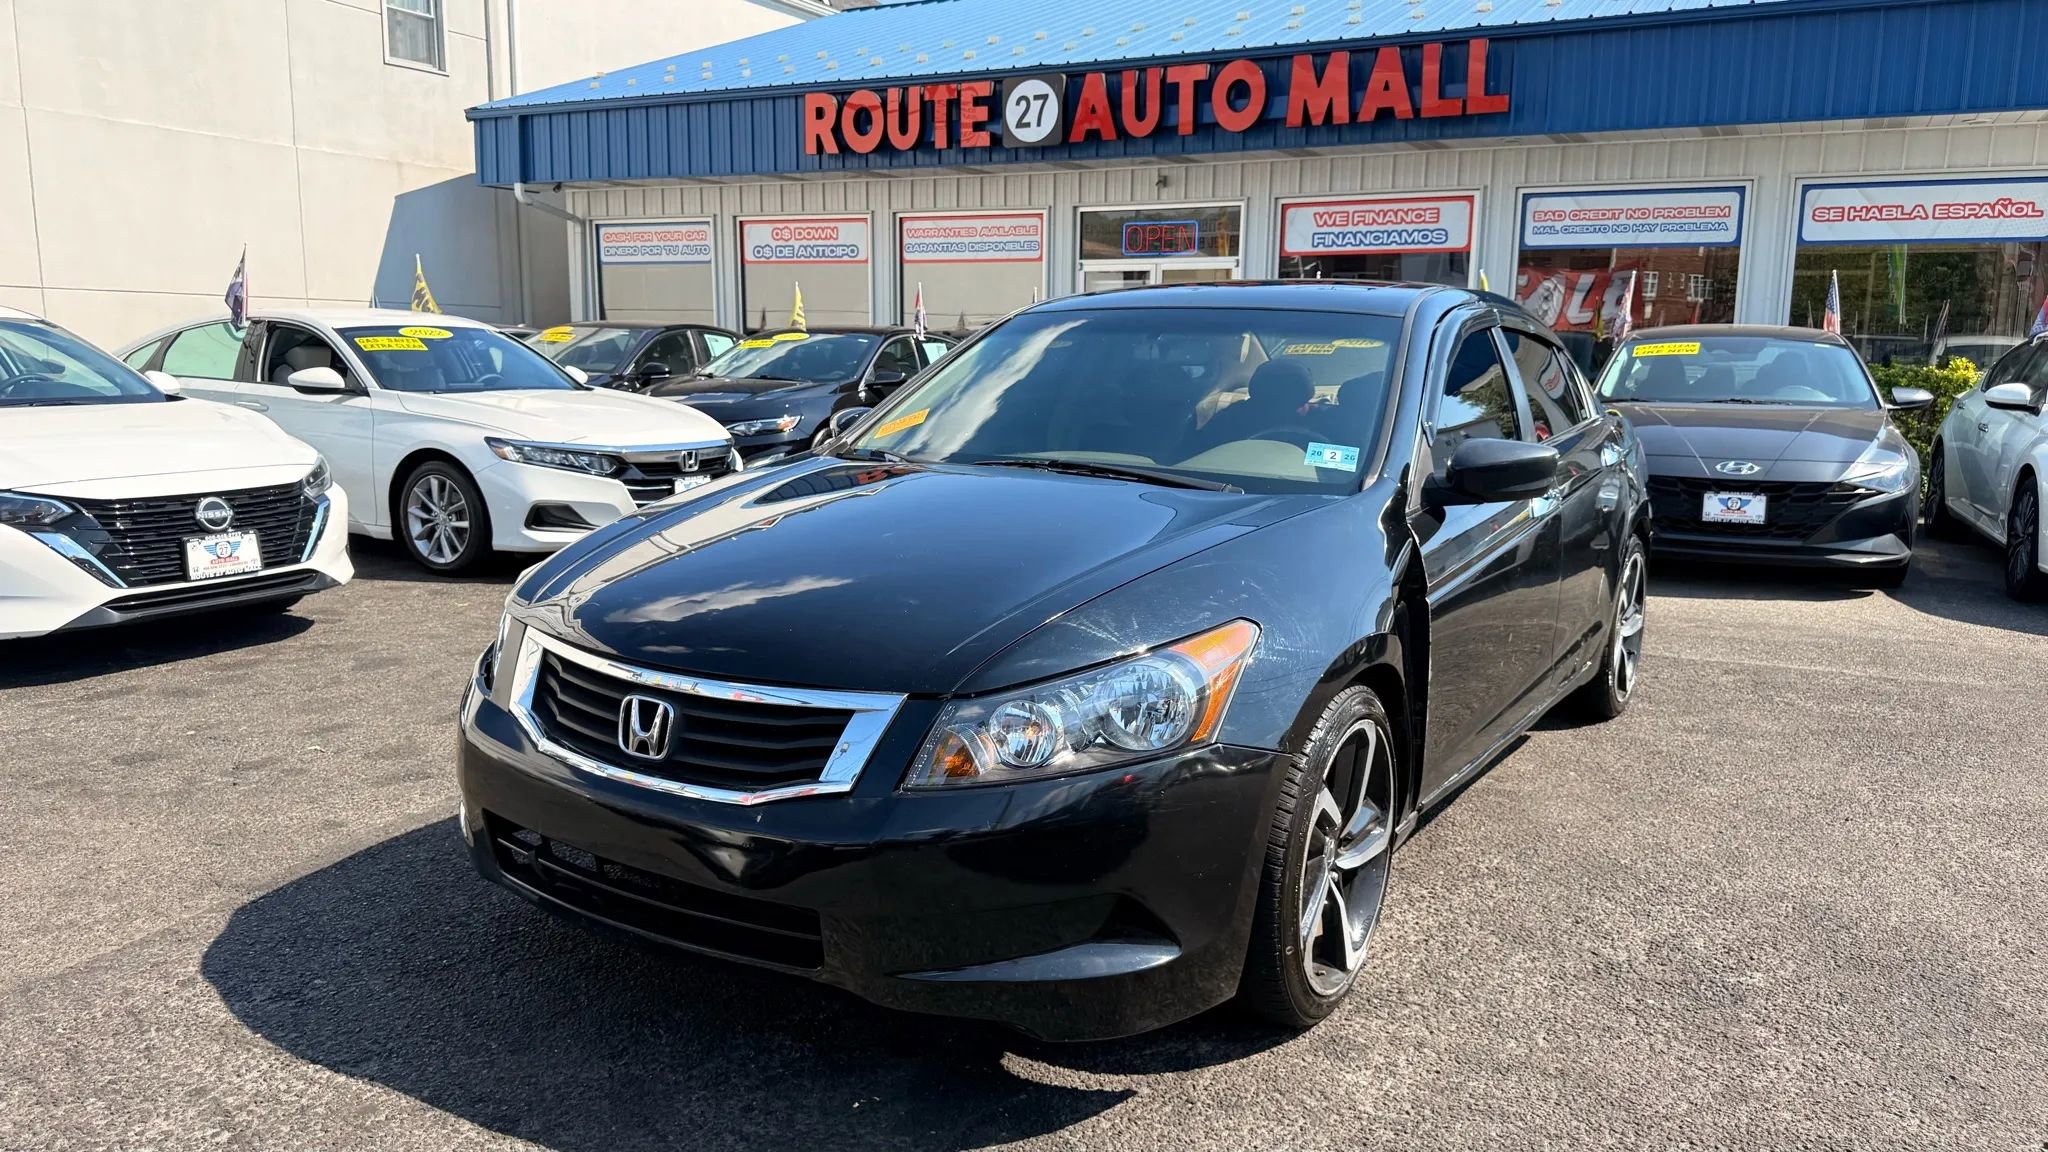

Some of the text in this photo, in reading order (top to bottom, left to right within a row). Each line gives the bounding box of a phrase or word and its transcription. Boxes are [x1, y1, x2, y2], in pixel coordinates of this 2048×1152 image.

[804, 38, 1510, 156] ROUTE 27 AUTO MALL
[1533, 206, 1731, 222] BAD CREDIT NO PROBLEM
[1812, 197, 2044, 222] SE HABLA ESPAÑOL
[1313, 208, 1440, 227] WE FINANCE
[793, 226, 839, 241] DOWN
[1532, 221, 1729, 234] MAL CREDITO NO HAY PROBLEMA
[604, 230, 706, 243] CASH FOR YOUR CAR
[1126, 225, 1196, 252] OPEN
[1312, 229, 1449, 248] FINANCIAMOS
[604, 244, 711, 256] DINERO POR TU AUTO
[775, 245, 796, 258] DE
[796, 243, 859, 259] ANTICIPO
[905, 240, 1040, 253] GARANTIAS DISPONIBLES
[1329, 451, 1337, 460] 2
[196, 508, 233, 519] NISSAN
[219, 546, 229, 556] 27
